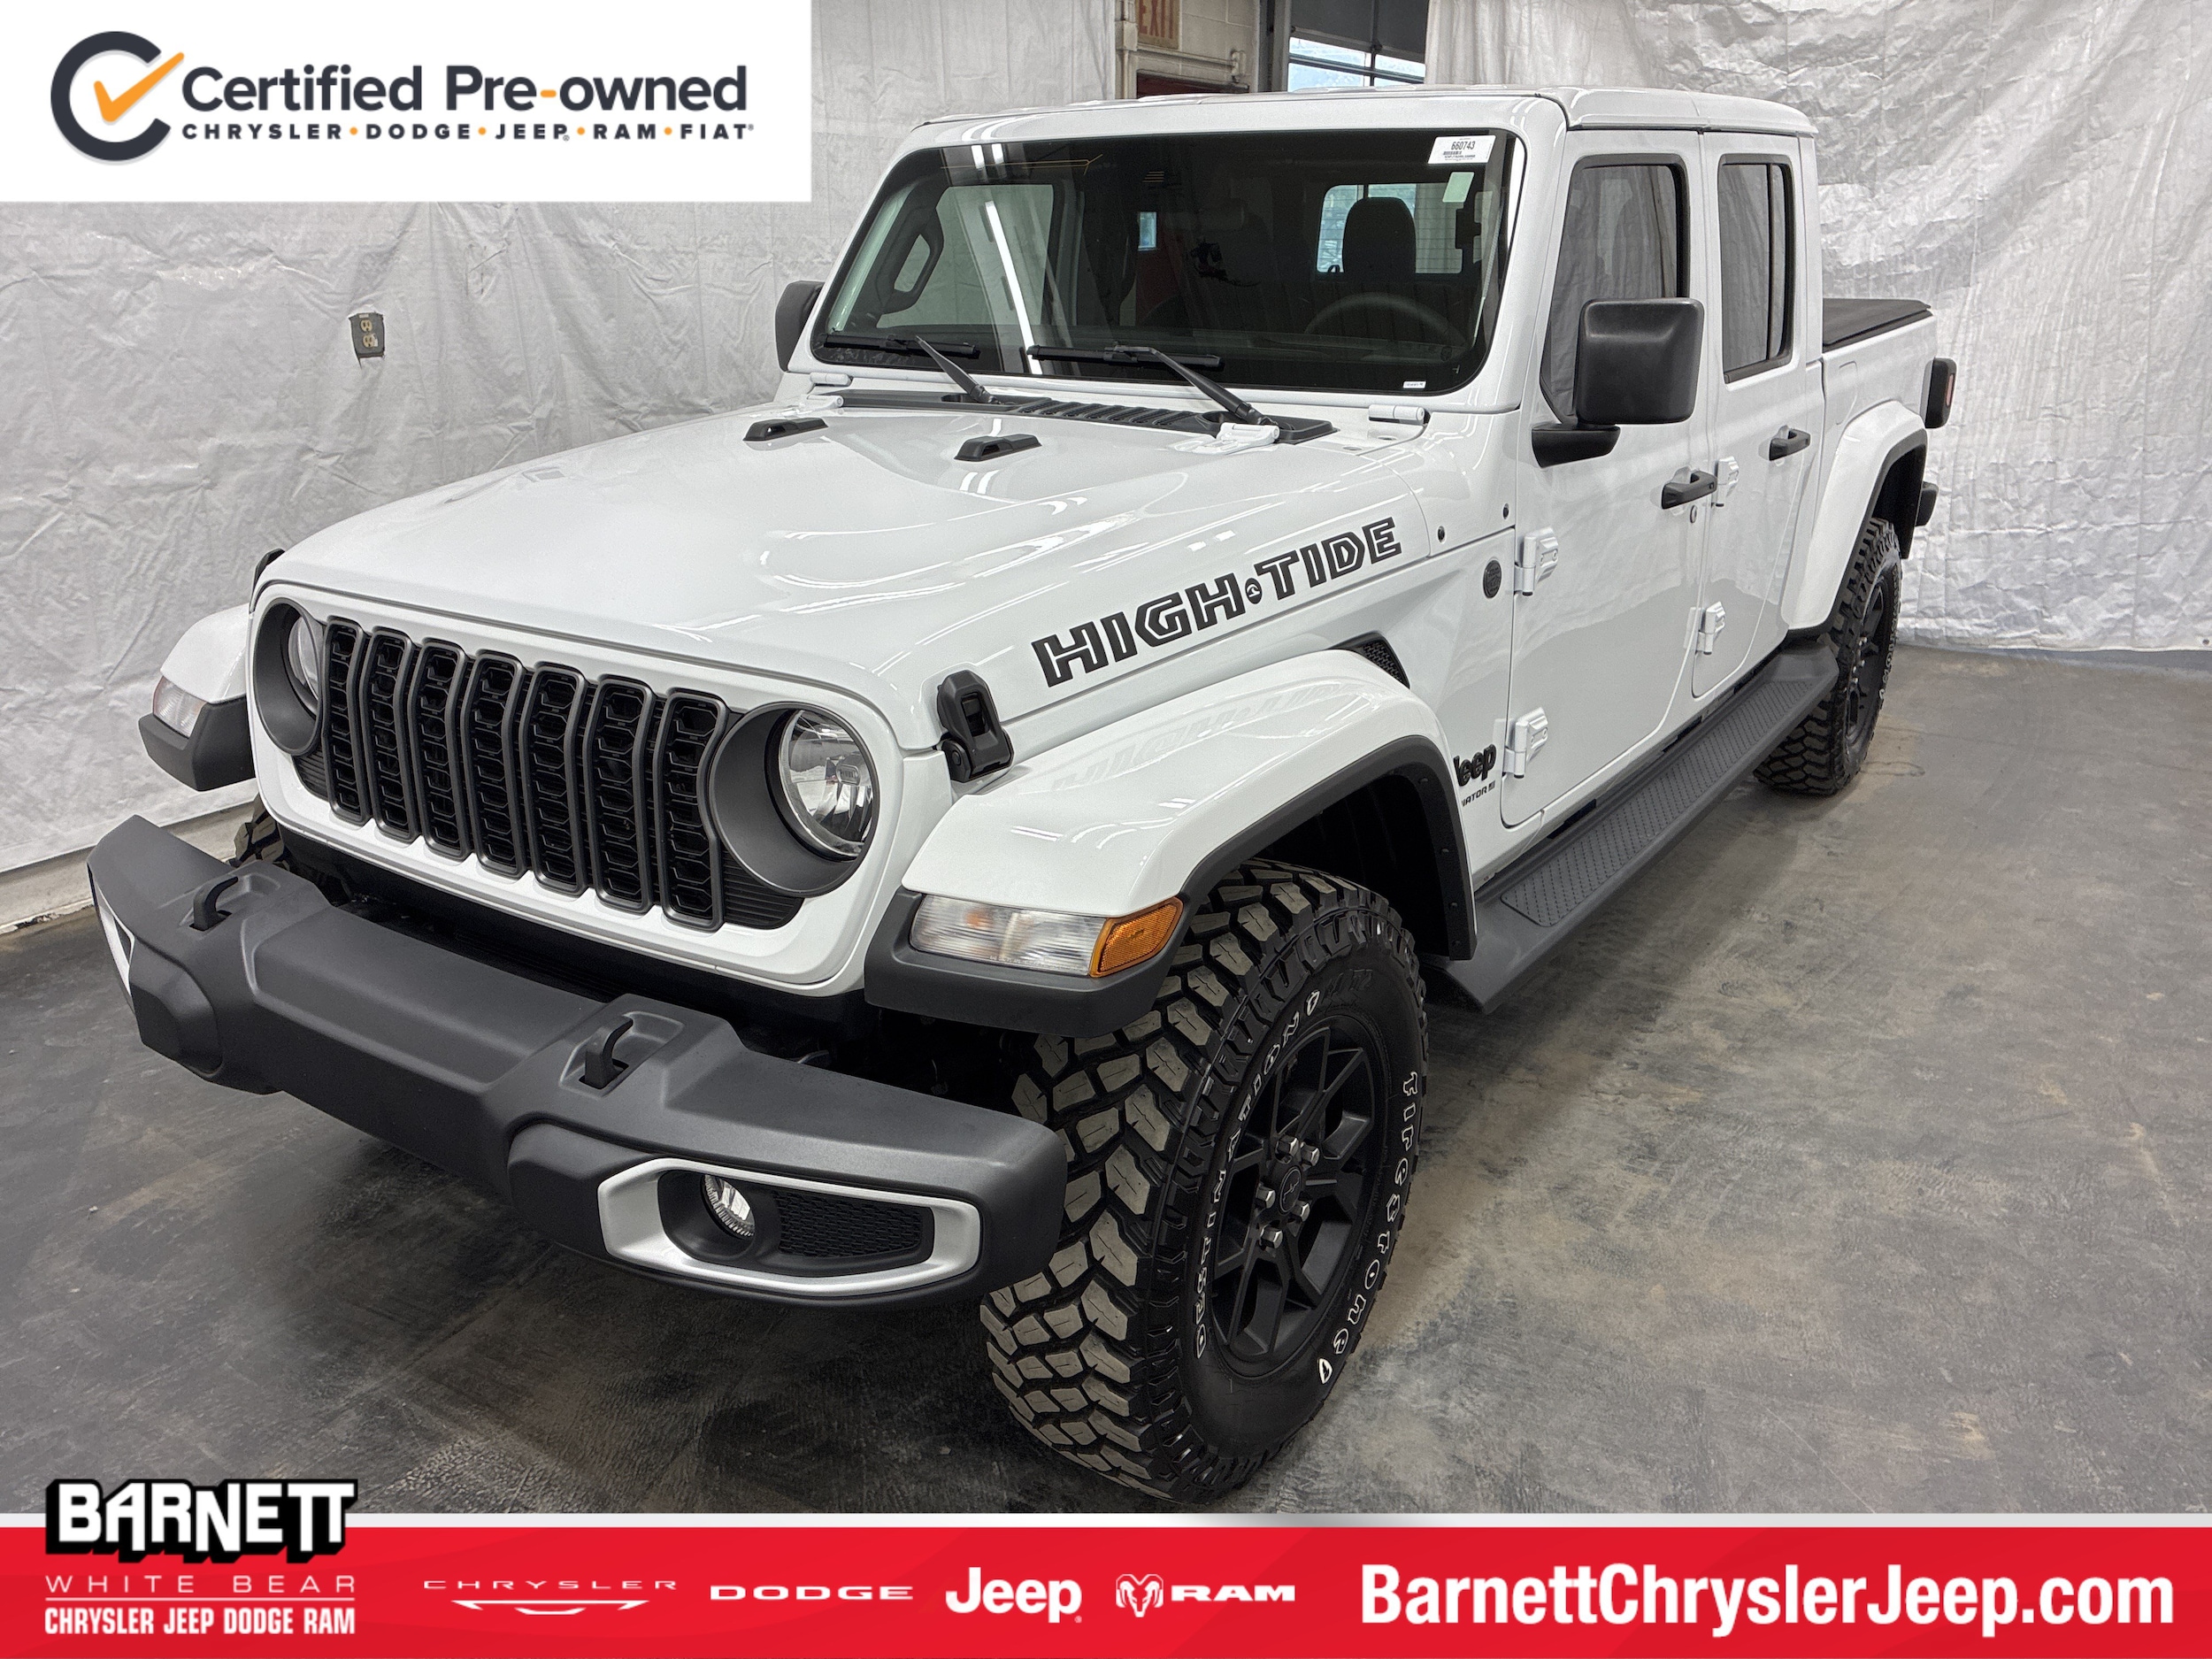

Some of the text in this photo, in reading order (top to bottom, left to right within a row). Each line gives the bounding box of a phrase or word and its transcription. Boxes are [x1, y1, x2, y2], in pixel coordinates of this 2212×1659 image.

[1451, 142, 1476, 150] 660743
[1031, 517, 1402, 687] HIGH TIDE
[1462, 786, 1487, 806] IATOR
